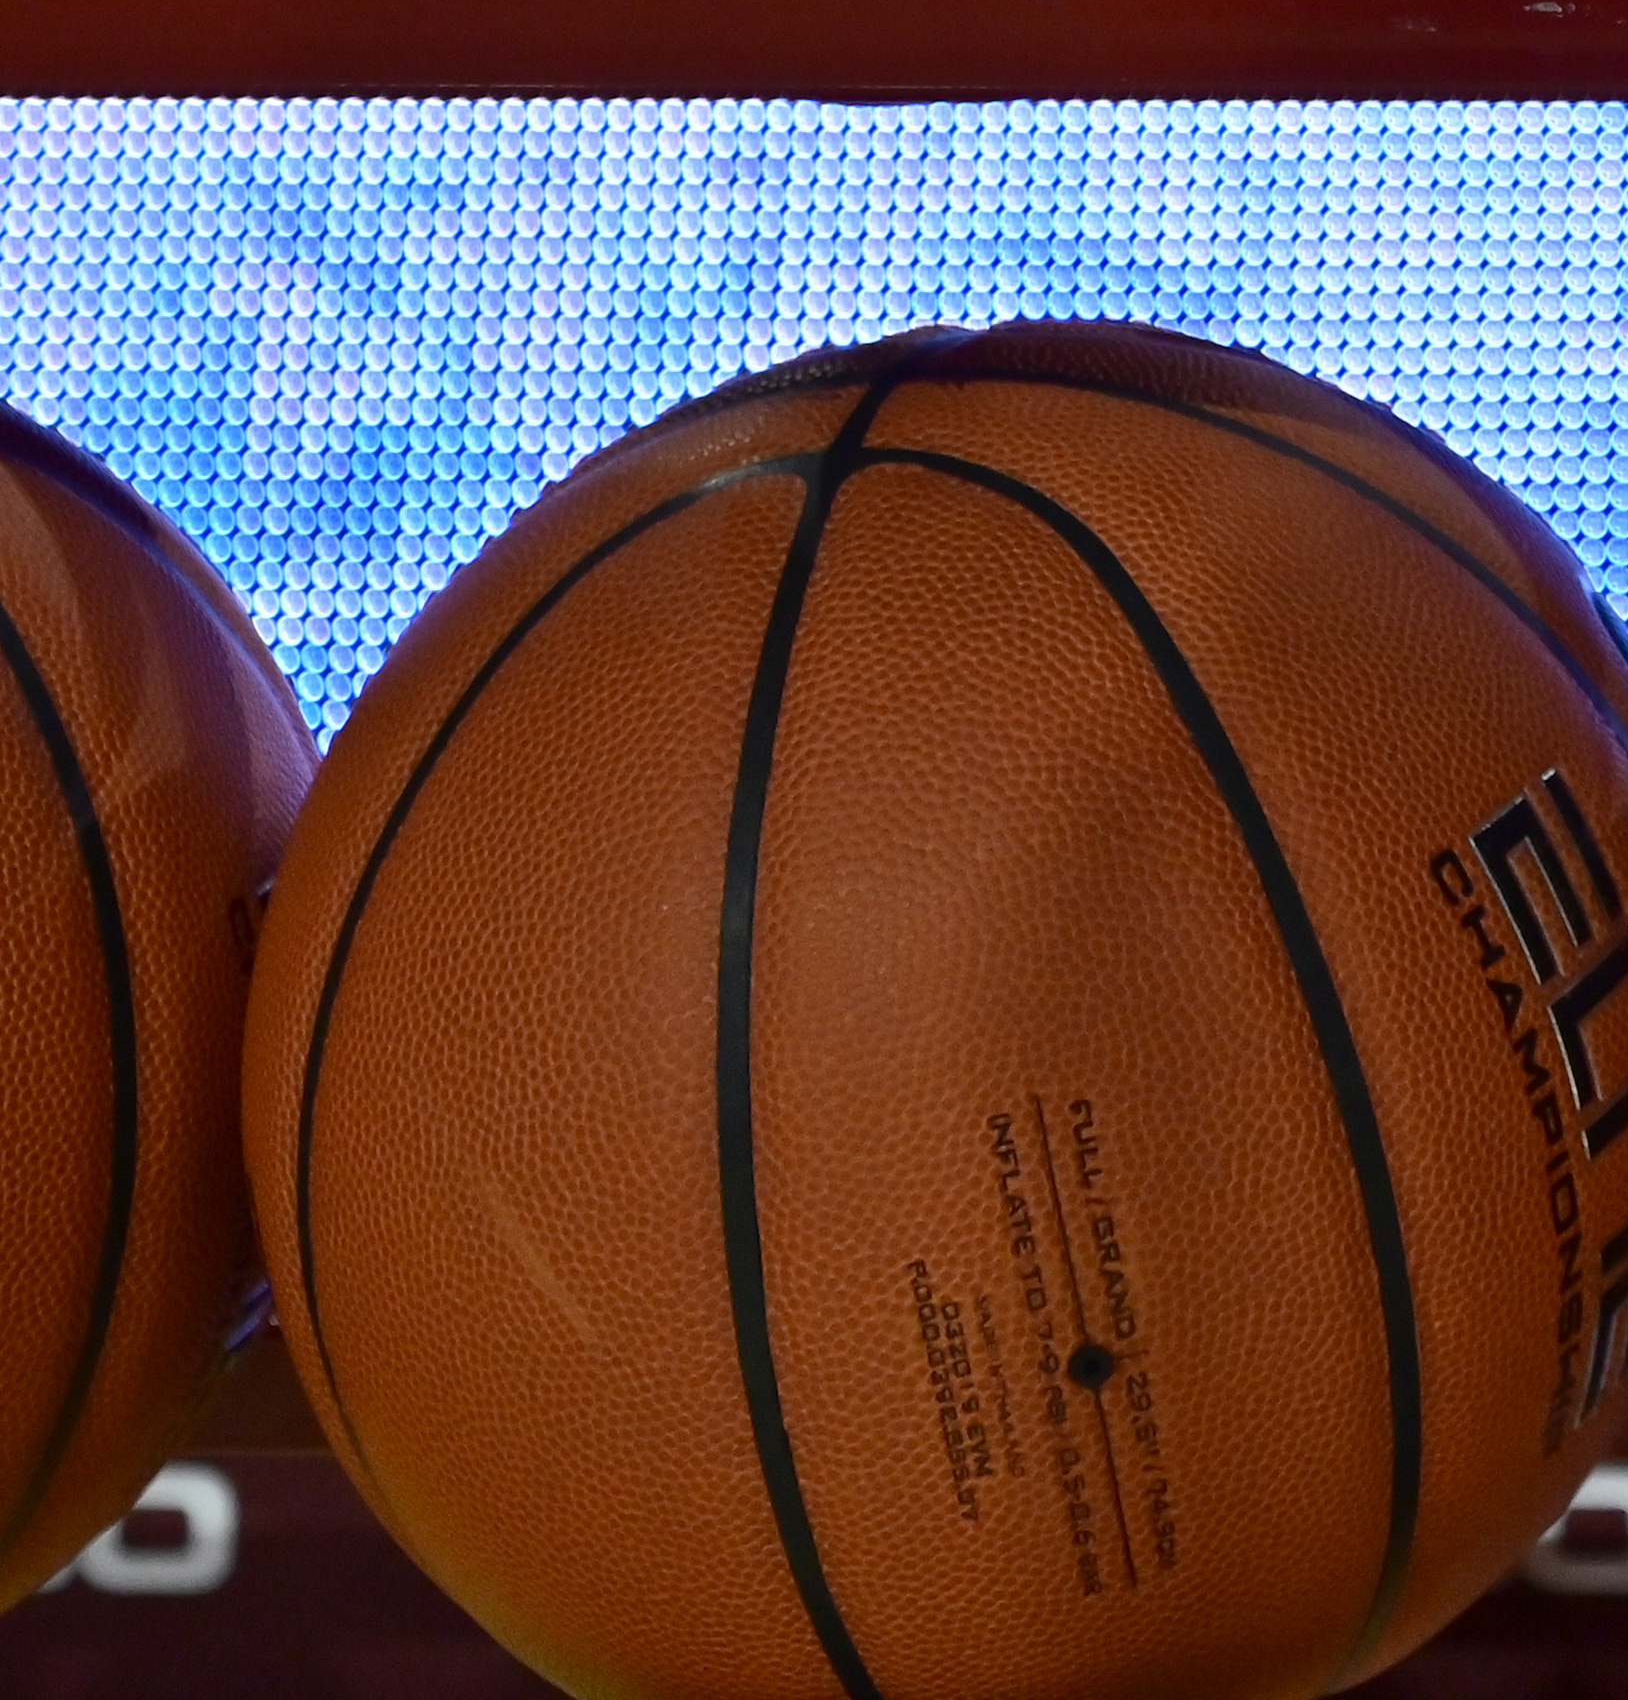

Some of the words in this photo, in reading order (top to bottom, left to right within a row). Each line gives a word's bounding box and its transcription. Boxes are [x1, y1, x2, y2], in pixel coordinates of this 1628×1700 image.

[986, 1112, 1037, 1257] INFLATE
[1019, 1265, 1049, 1312] TO
[1067, 1097, 1105, 1189] FULL
[1090, 1213, 1136, 1340] GRAND
